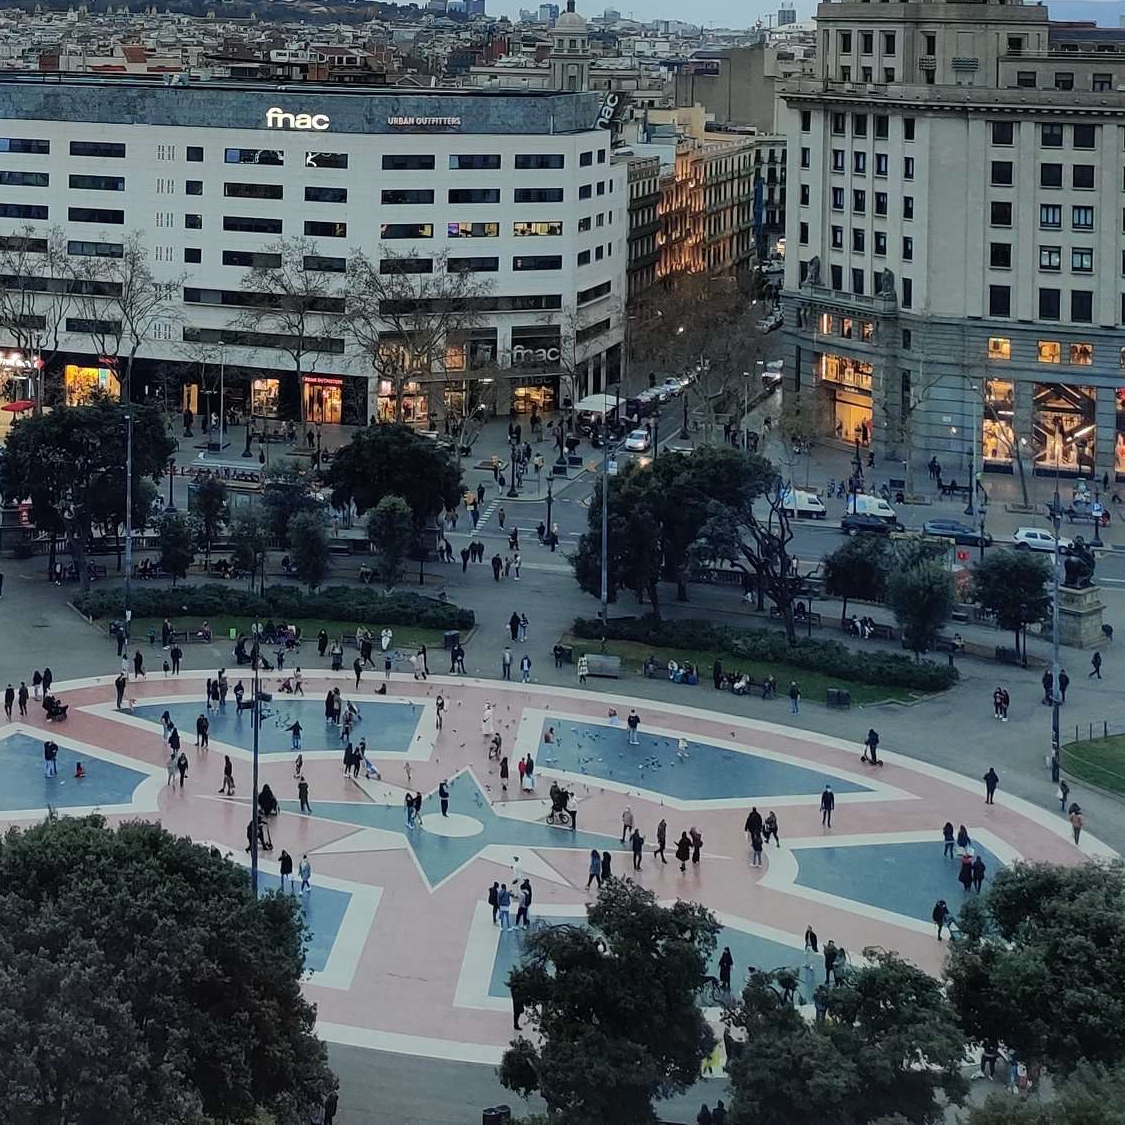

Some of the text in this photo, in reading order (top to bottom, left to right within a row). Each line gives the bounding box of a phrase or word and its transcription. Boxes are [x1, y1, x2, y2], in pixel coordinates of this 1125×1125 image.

[266, 107, 330, 130] fnac
[387, 116, 461, 126] URBAN OUTFITTERS
[596, 93, 619, 129] nac
[513, 344, 560, 362] fnac
